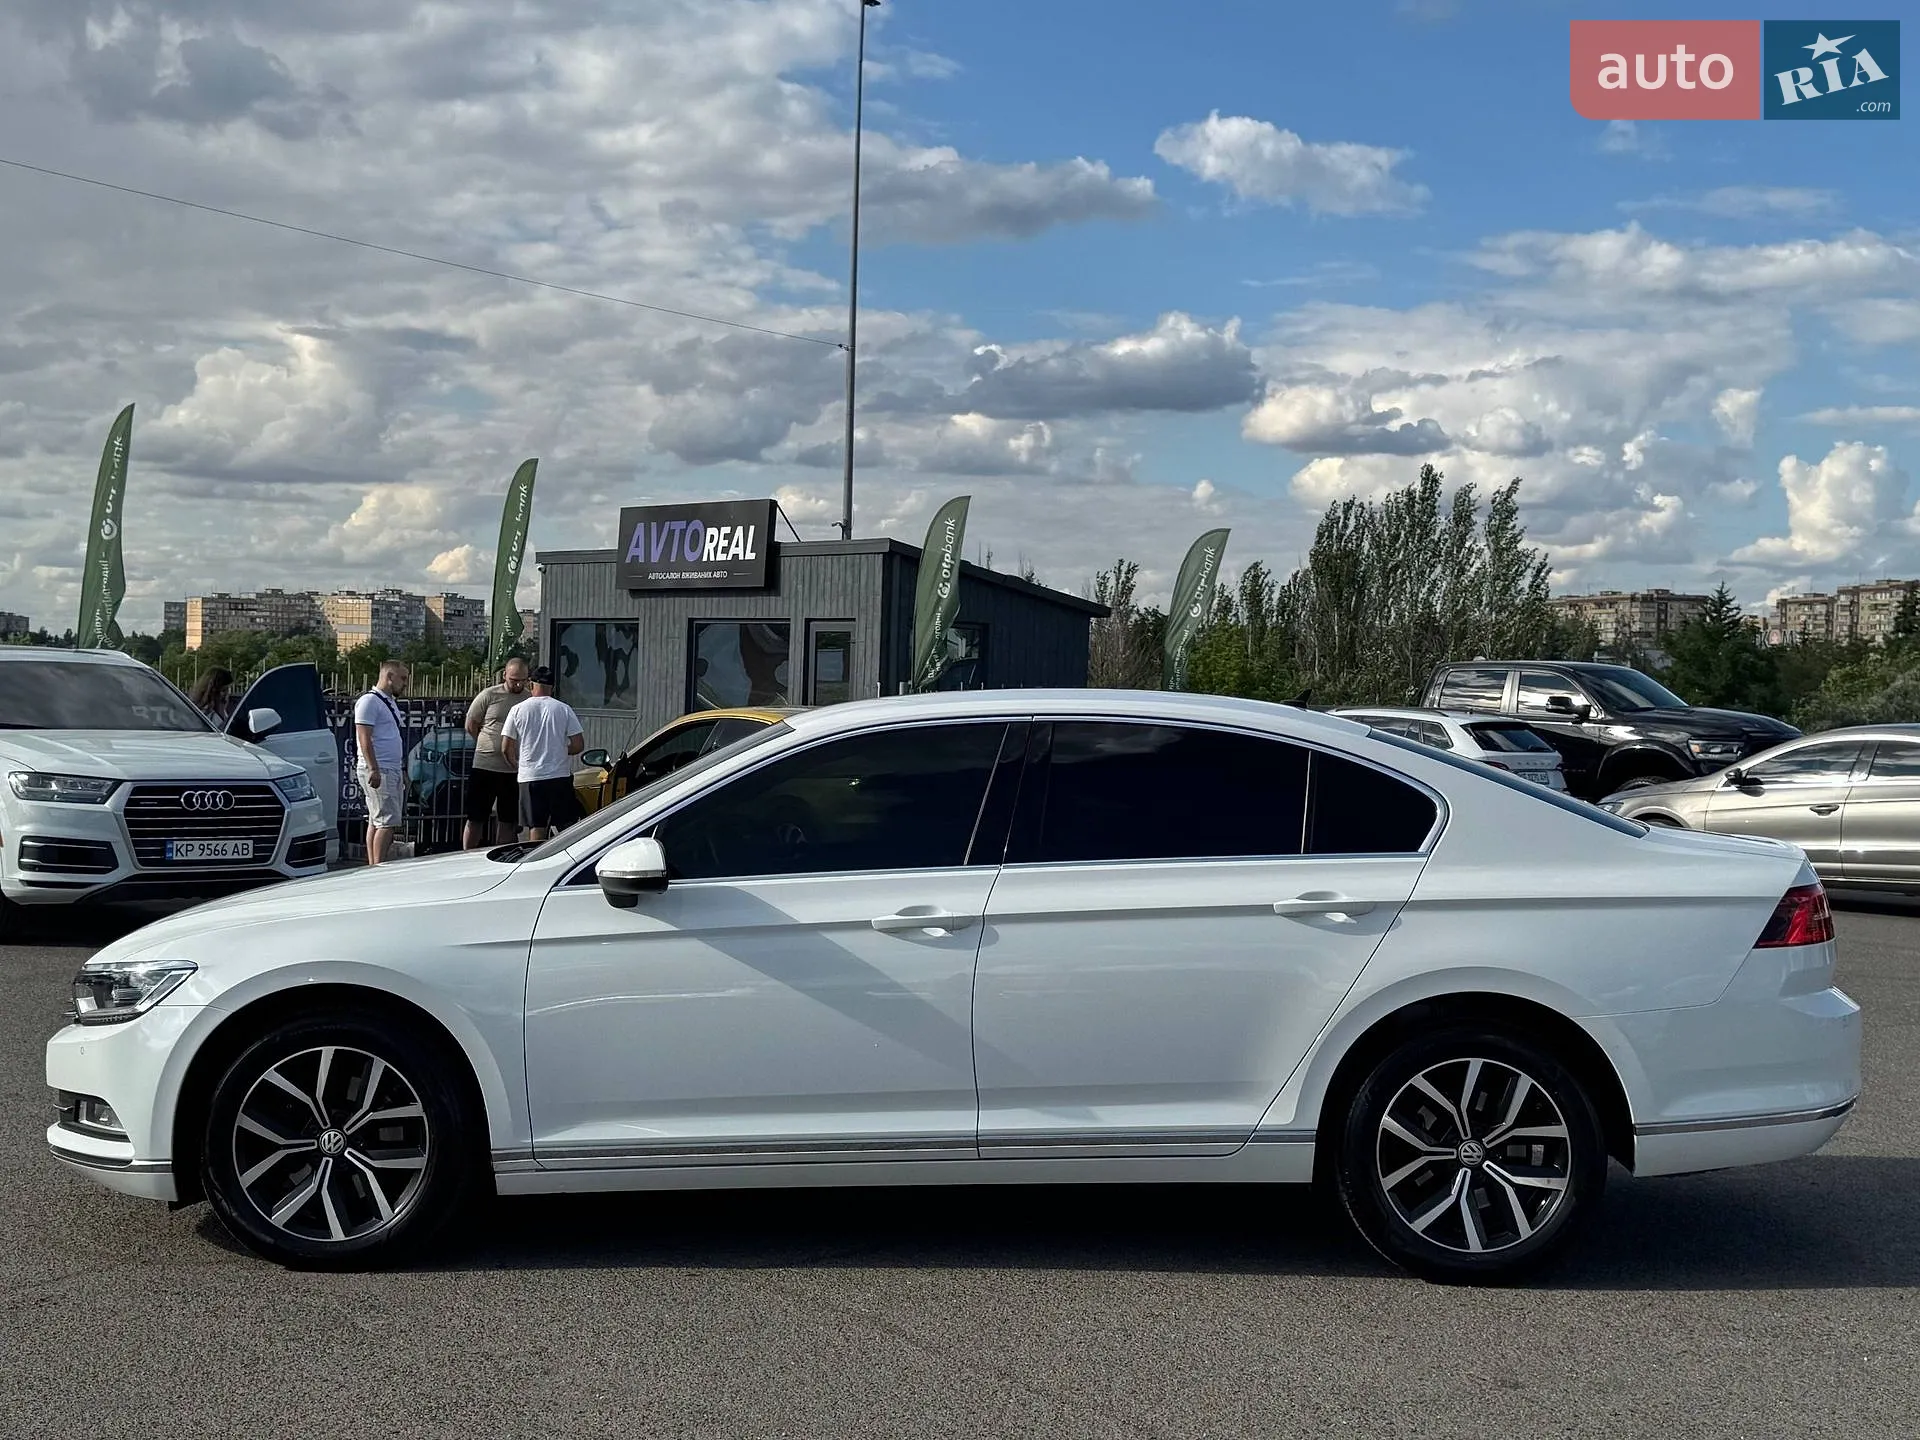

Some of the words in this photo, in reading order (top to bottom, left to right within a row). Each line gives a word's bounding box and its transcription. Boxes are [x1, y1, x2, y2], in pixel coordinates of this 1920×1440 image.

[941, 517, 956, 579] otpbank
[712, 570, 728, 579] АВТО
[175, 843, 195, 857] KP
[198, 843, 228, 856] 9566
[231, 842, 250, 856] AB
